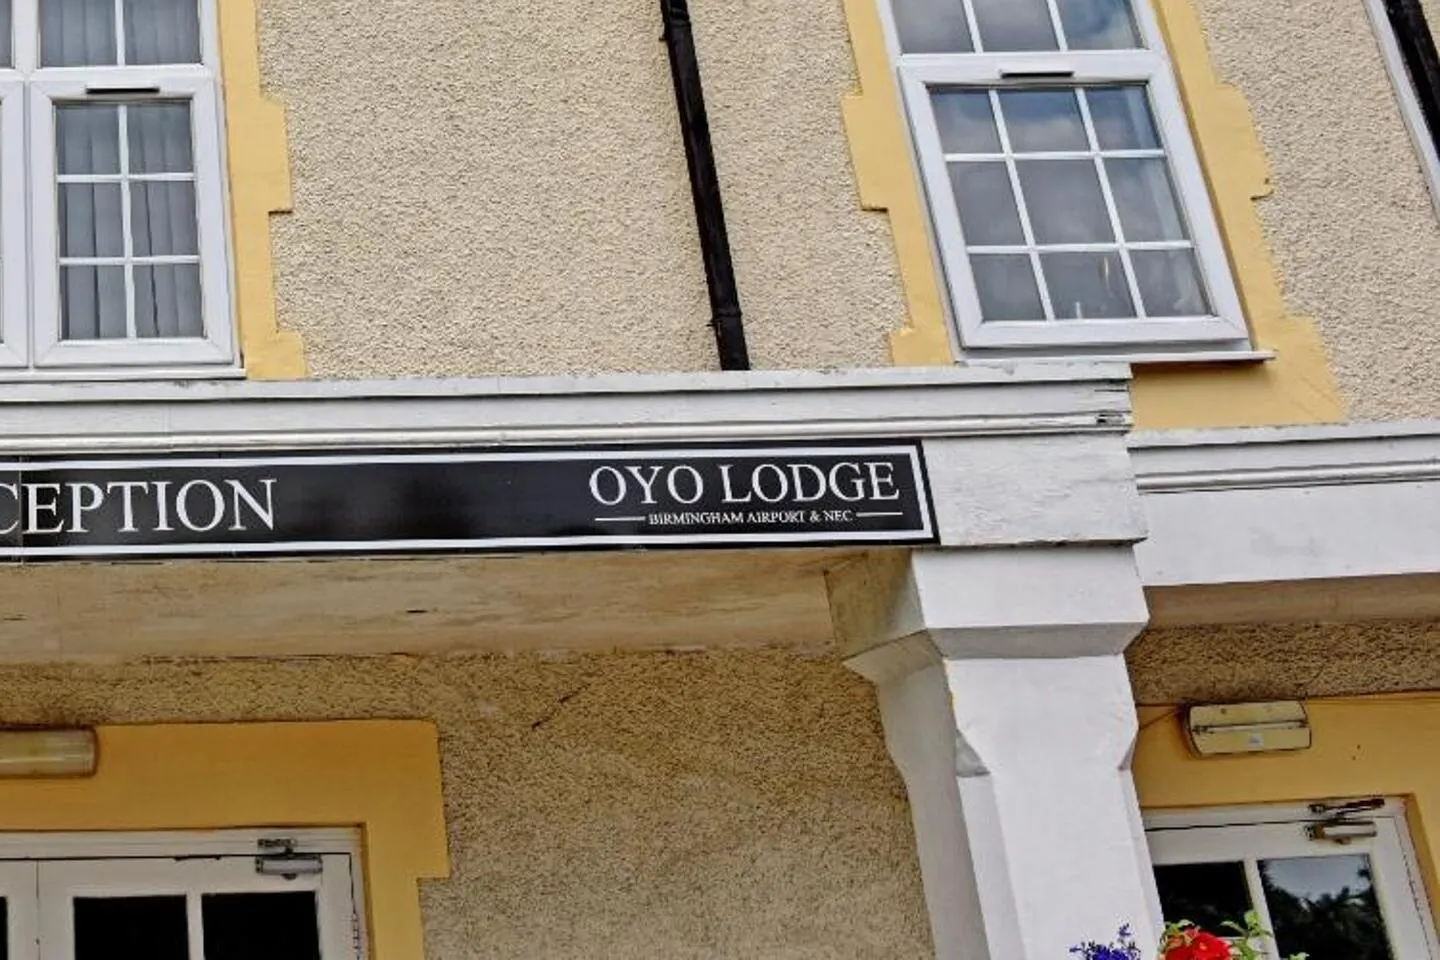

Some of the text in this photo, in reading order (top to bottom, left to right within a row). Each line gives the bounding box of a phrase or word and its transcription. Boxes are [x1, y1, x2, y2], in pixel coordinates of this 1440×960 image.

[589, 461, 900, 505] OYO LODGE
[648, 509, 853, 525] BIRMINGHAM AIRPORT & NEC
